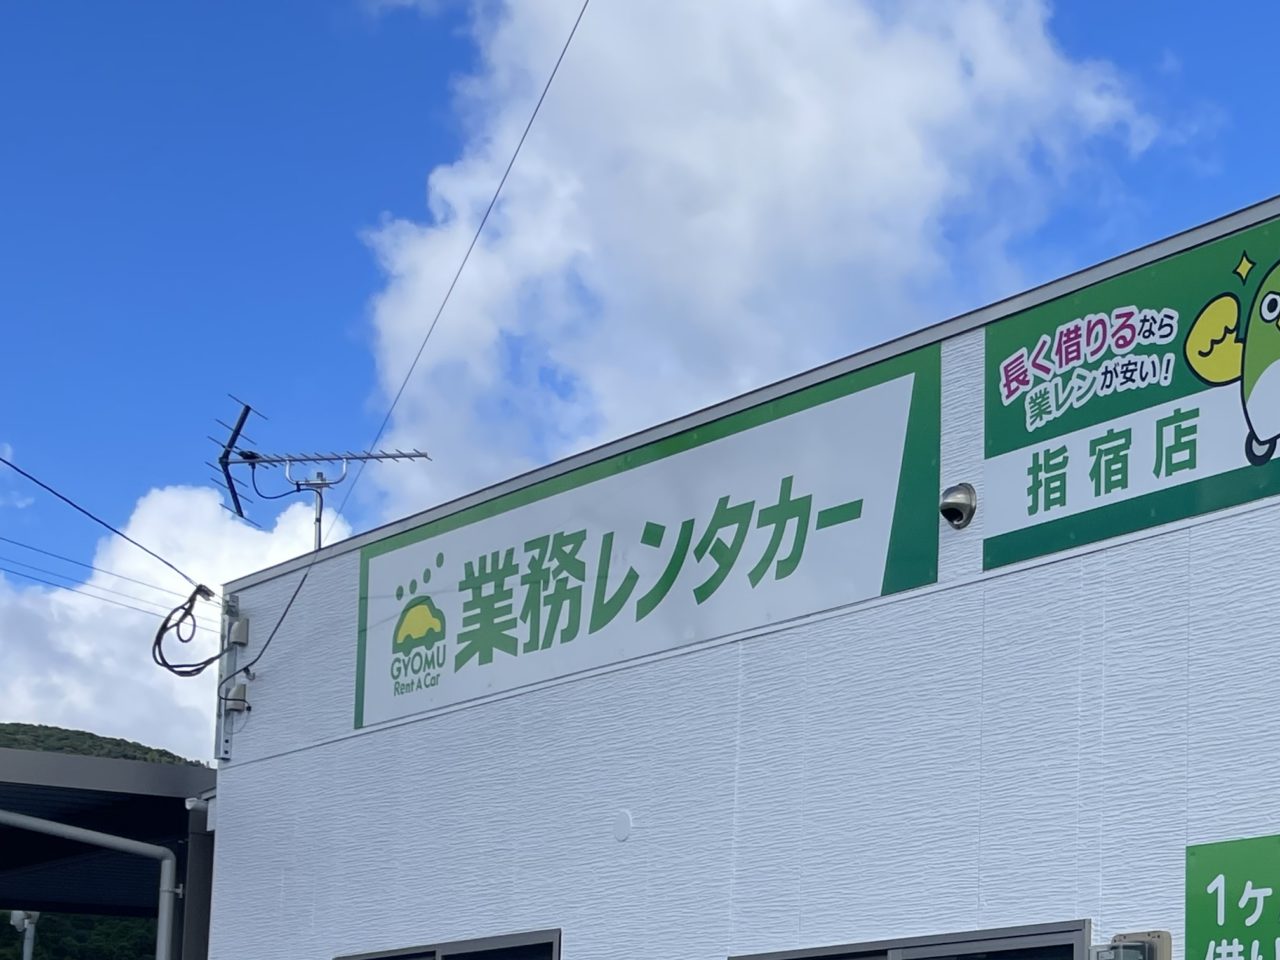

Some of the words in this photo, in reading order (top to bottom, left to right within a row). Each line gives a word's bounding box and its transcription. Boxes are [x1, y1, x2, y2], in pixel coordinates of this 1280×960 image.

[1001, 309, 1175, 400] 長く借りるなら
[1025, 357, 1173, 427] 業レンが安い！
[1026, 407, 1200, 516] 指宿店
[454, 475, 864, 673] 業務レンタカー
[391, 644, 446, 680] GYOMU
[394, 679, 414, 696] Rent
[416, 677, 423, 690] A
[424, 672, 440, 688] Car
